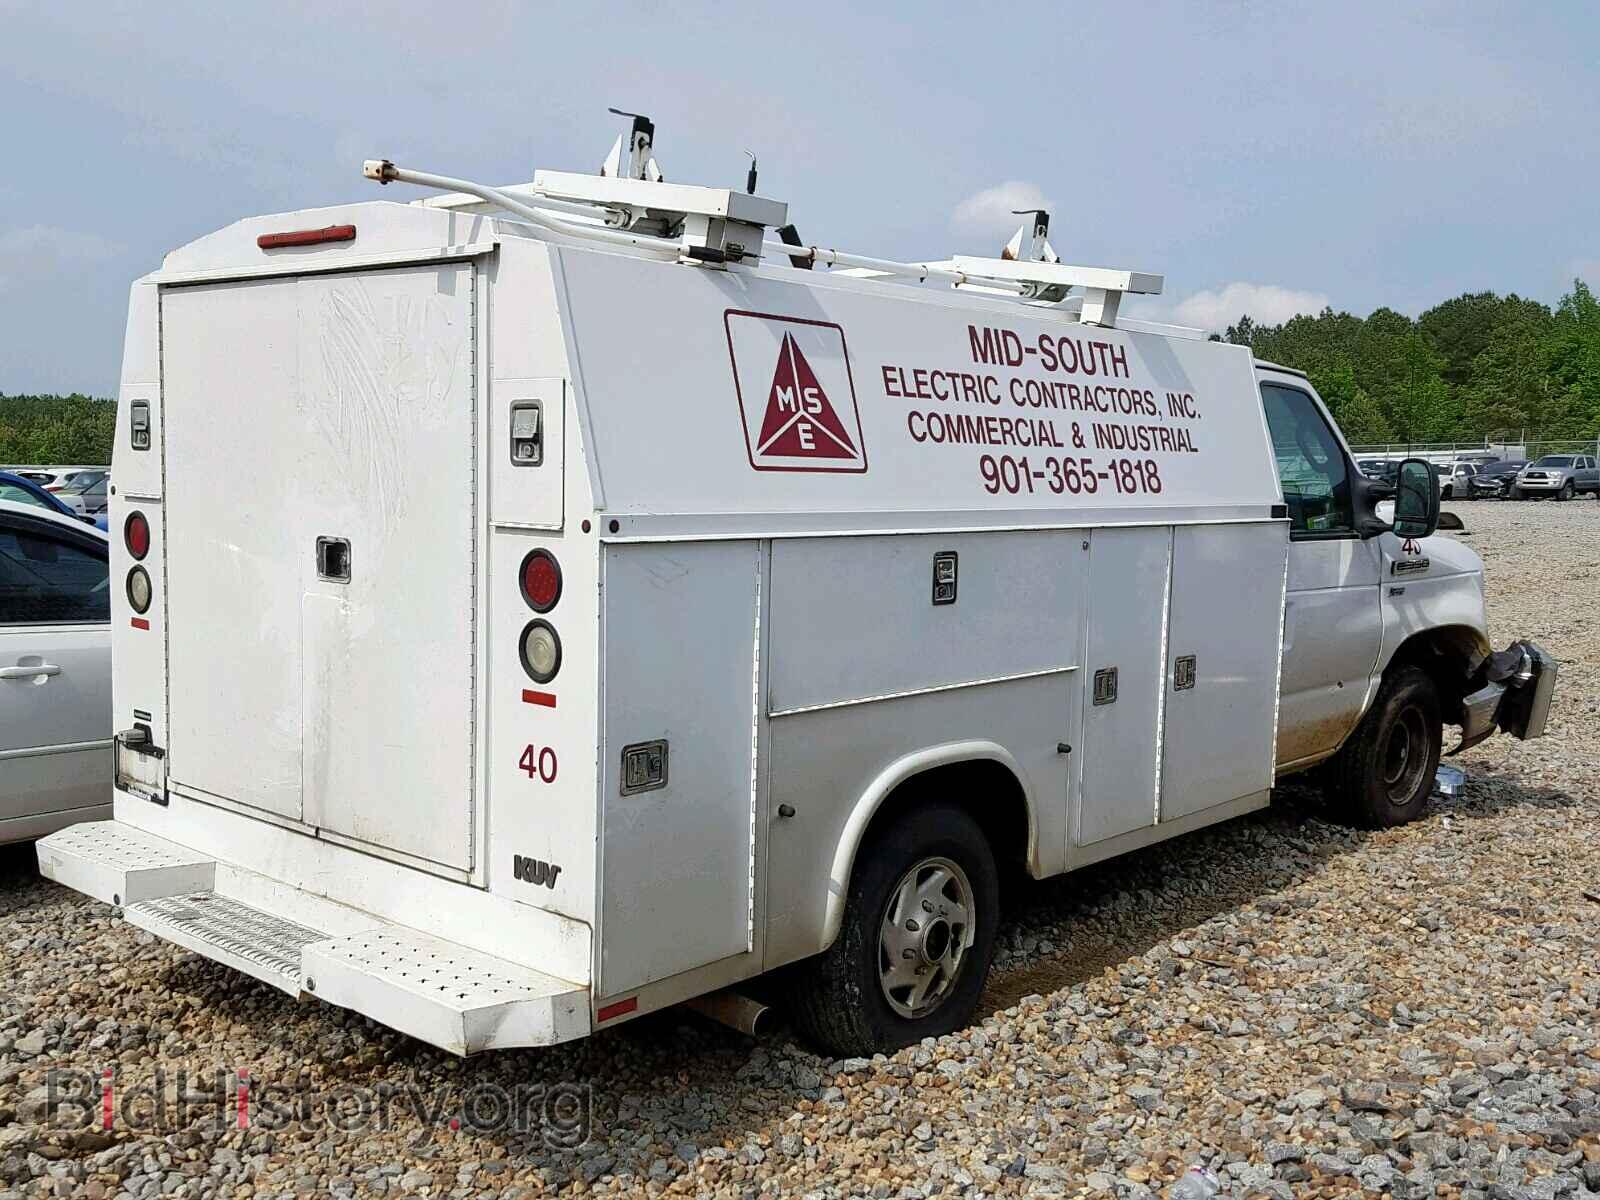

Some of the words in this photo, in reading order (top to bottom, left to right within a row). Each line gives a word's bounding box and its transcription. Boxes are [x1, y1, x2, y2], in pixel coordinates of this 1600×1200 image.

[968, 325, 1129, 378] MID-SOUTH
[881, 366, 1001, 403] ELECTRIC
[1010, 380, 1163, 421] CONTRACTORS,
[1167, 393, 1202, 420] INC.
[908, 411, 1063, 449] COMMERCIAL
[1072, 422, 1086, 447] &
[1092, 423, 1198, 452] INDUSTRIAL
[980, 455, 1162, 495] 901-365-1818
[518, 744, 558, 784] 40
[513, 854, 562, 889] KUV
